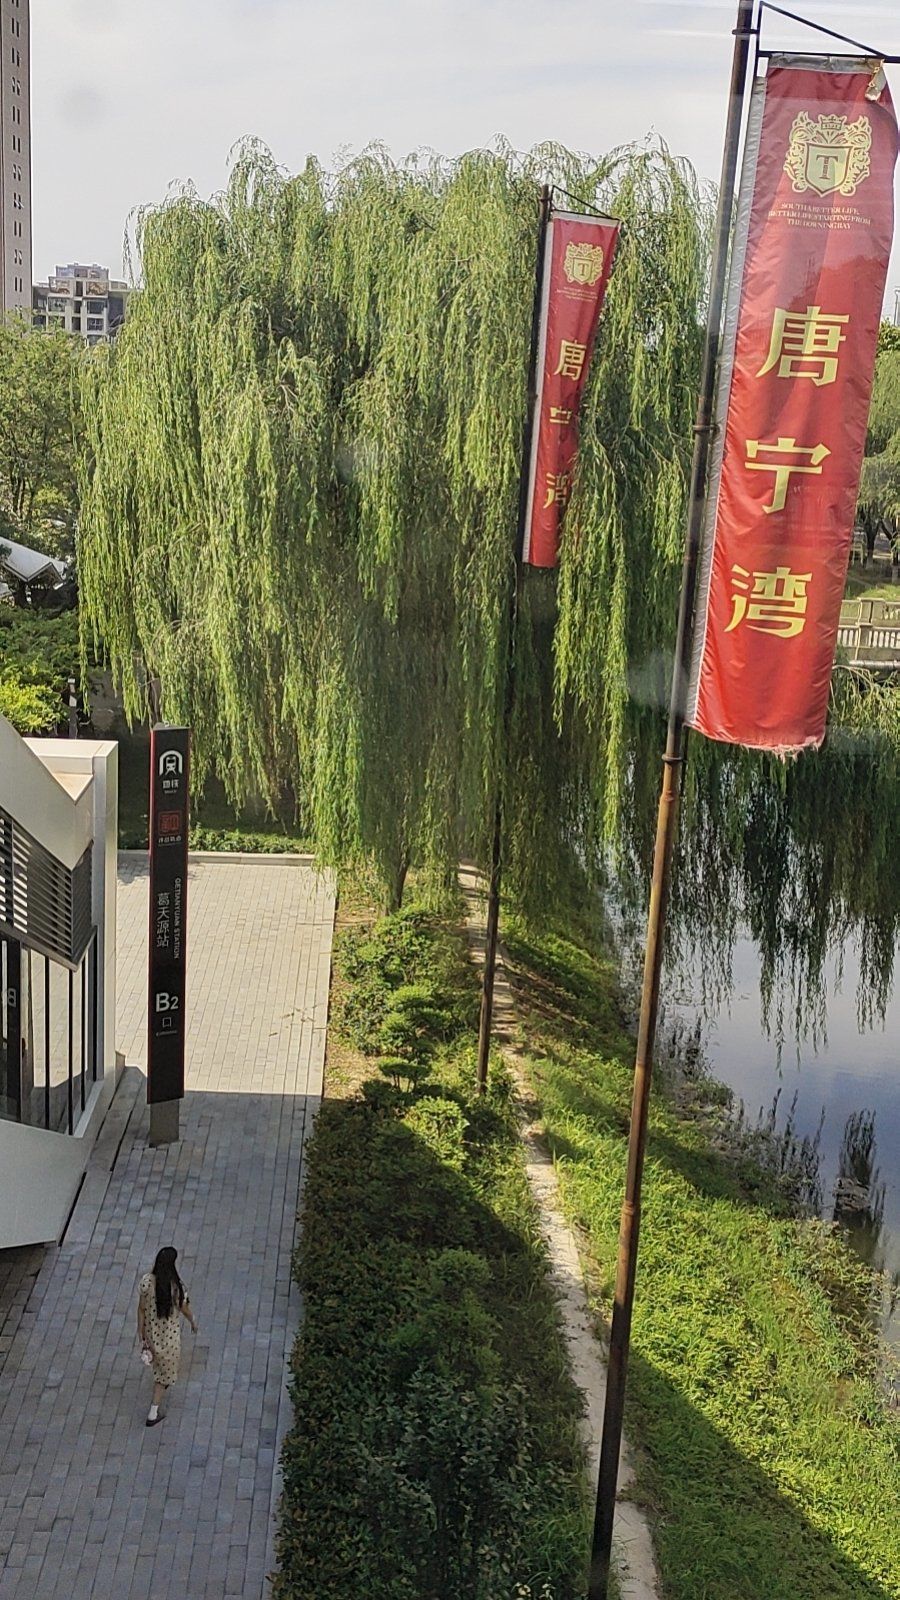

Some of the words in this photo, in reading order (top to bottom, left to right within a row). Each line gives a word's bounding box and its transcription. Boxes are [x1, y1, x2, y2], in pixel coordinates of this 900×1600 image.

[724, 305, 850, 638] 唐宁湾
[174, 877, 182, 926] GETIANYUAN
[173, 928, 181, 959] STATION
[155, 992, 179, 1012] B2
